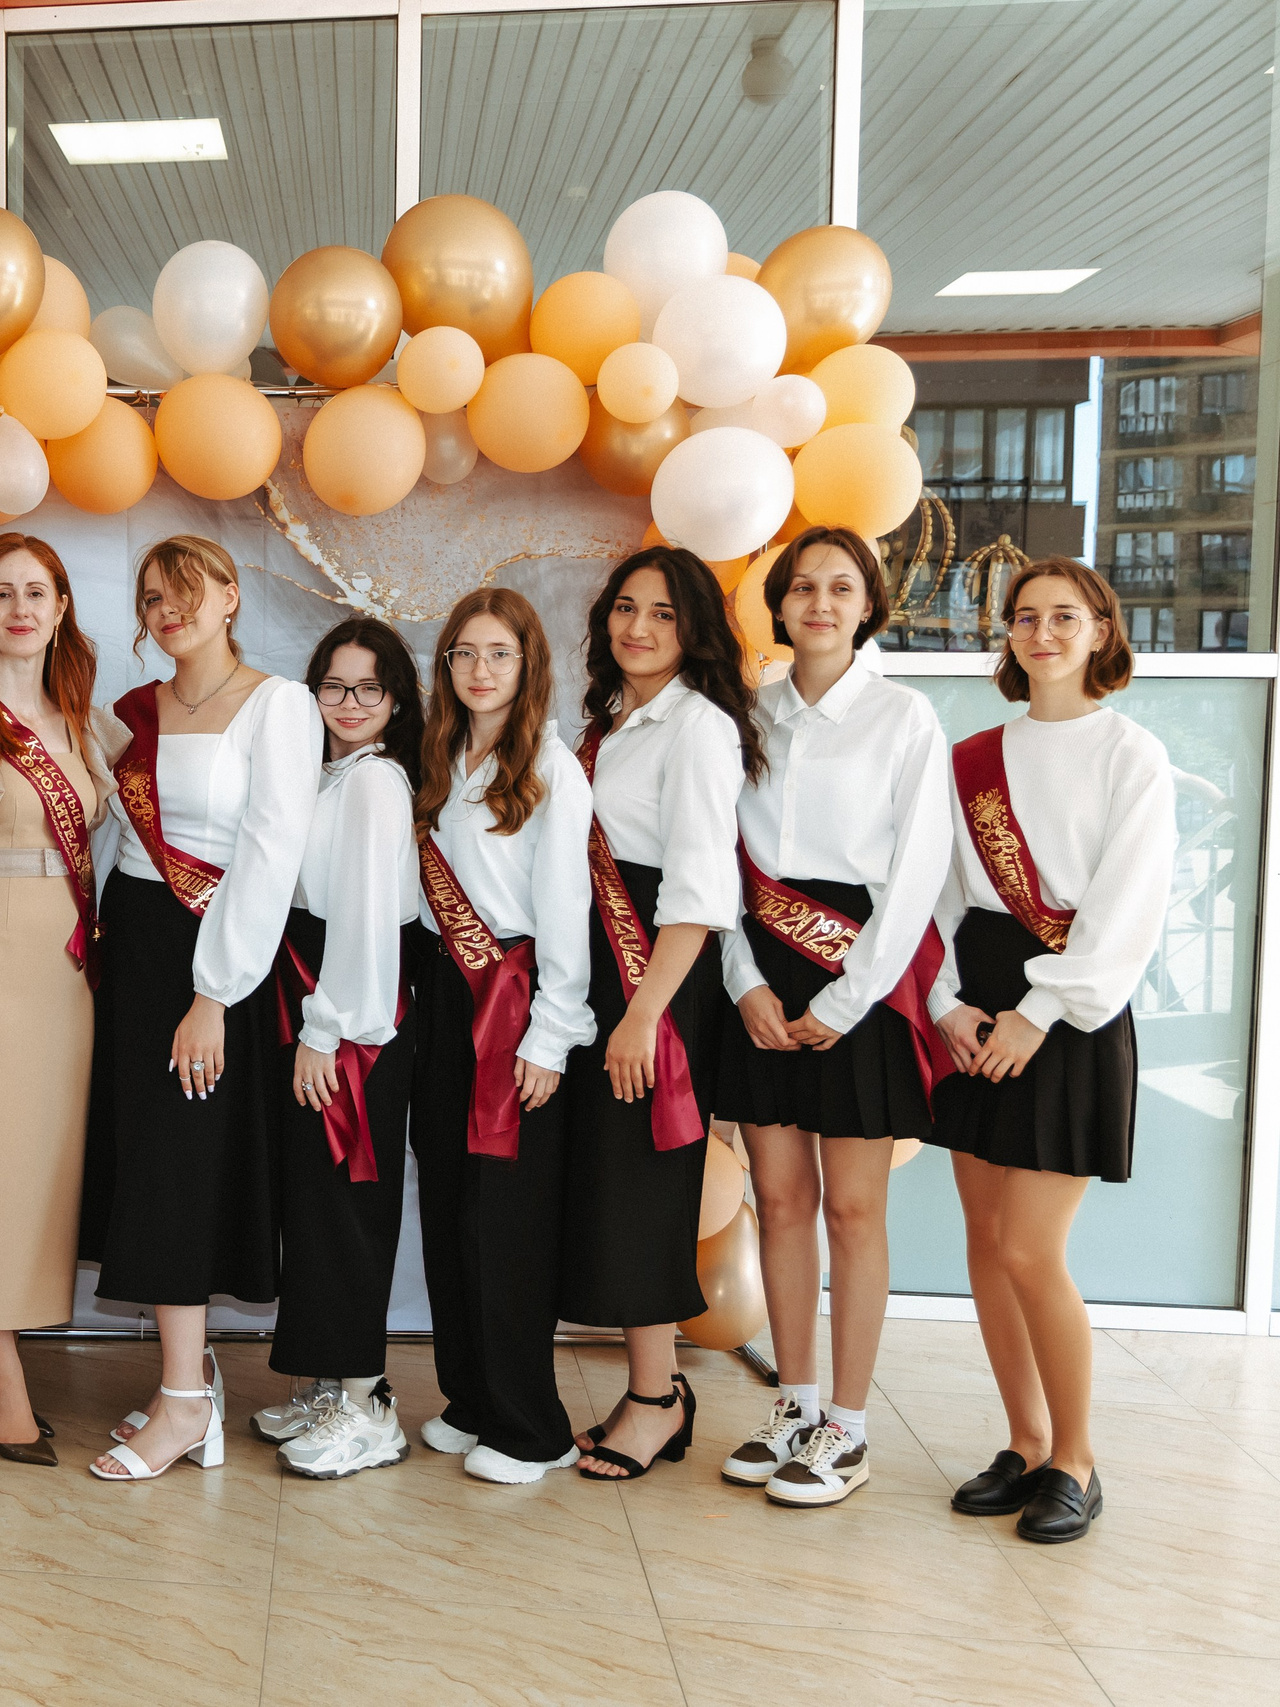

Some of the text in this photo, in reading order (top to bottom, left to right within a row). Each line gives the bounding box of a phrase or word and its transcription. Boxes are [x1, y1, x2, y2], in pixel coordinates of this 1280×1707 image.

[23, 735, 86, 827] Классный
[438, 903, 504, 971] 2025
[772, 901, 859, 962] 2025
